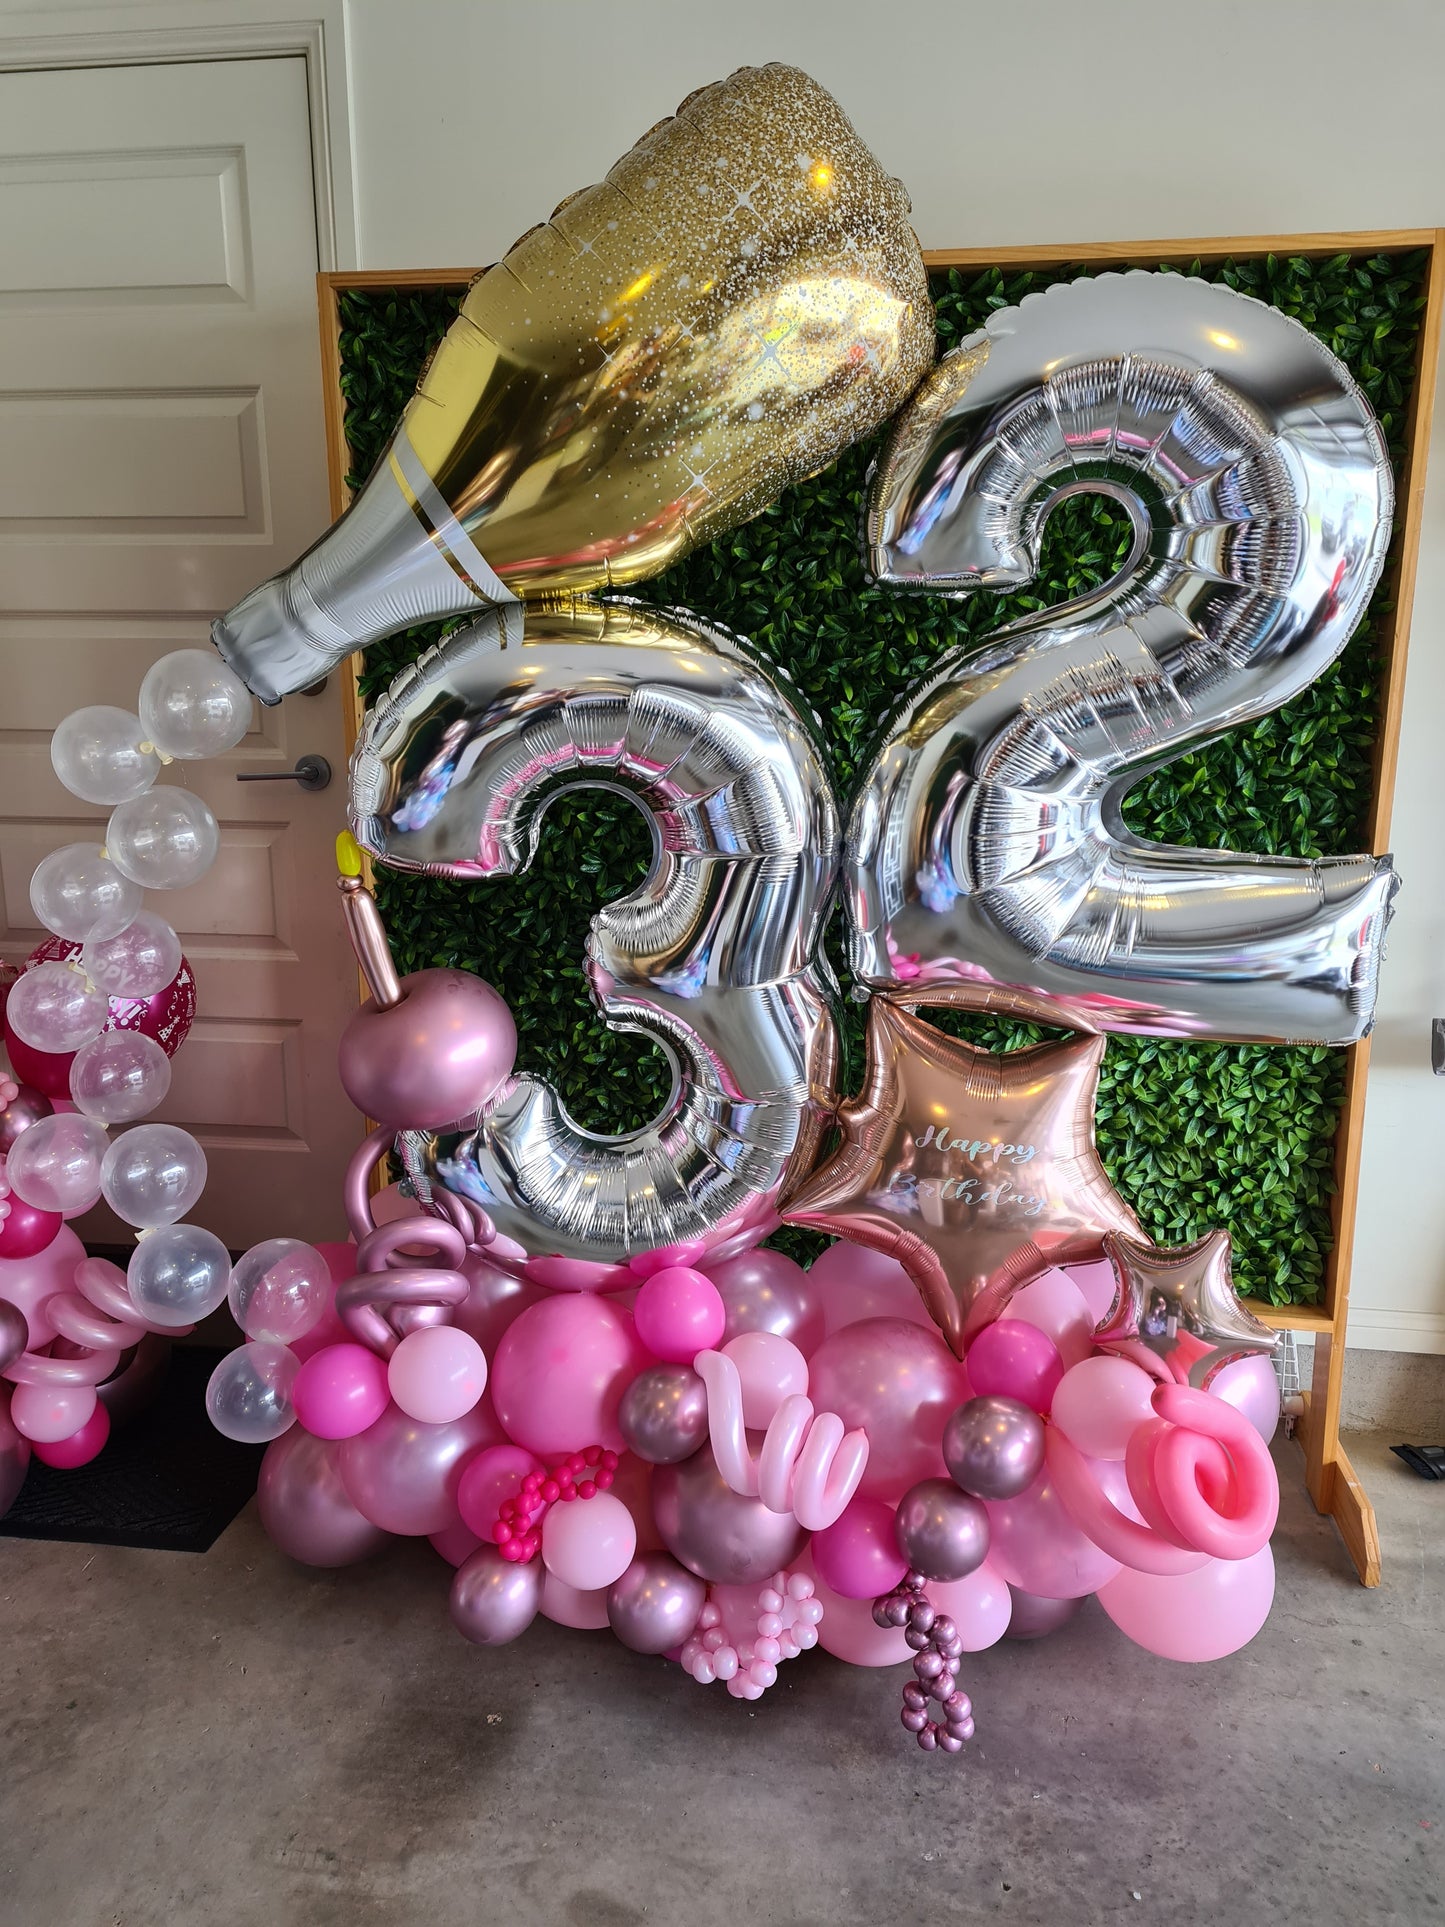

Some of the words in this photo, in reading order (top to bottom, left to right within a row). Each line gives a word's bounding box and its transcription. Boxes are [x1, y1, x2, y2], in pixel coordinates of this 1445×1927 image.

[851, 269, 1401, 1047] 2
[915, 1125, 1040, 1164] Happy
[888, 1171, 1047, 1215] Birthday
